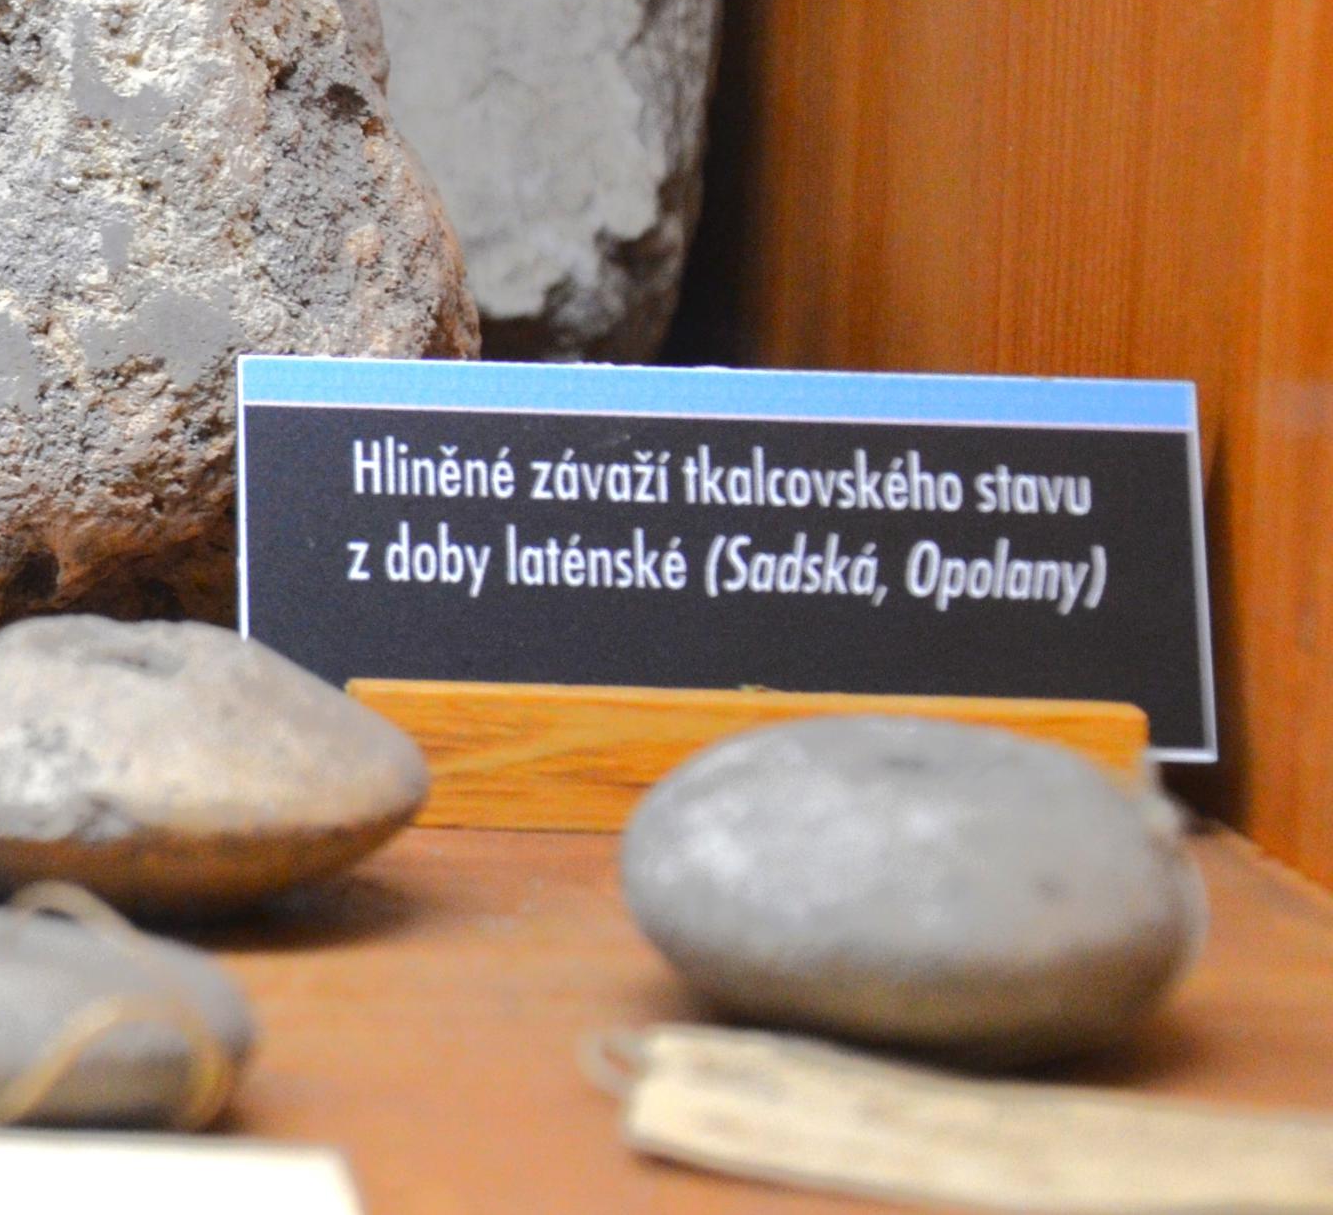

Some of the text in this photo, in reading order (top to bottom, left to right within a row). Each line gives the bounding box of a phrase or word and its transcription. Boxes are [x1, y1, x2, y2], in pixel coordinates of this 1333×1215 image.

[353, 437, 1092, 515] Hliněné závaží tkalcovského stavu
[346, 522, 1108, 615] z doby laténské (Sadská, Opolany)
